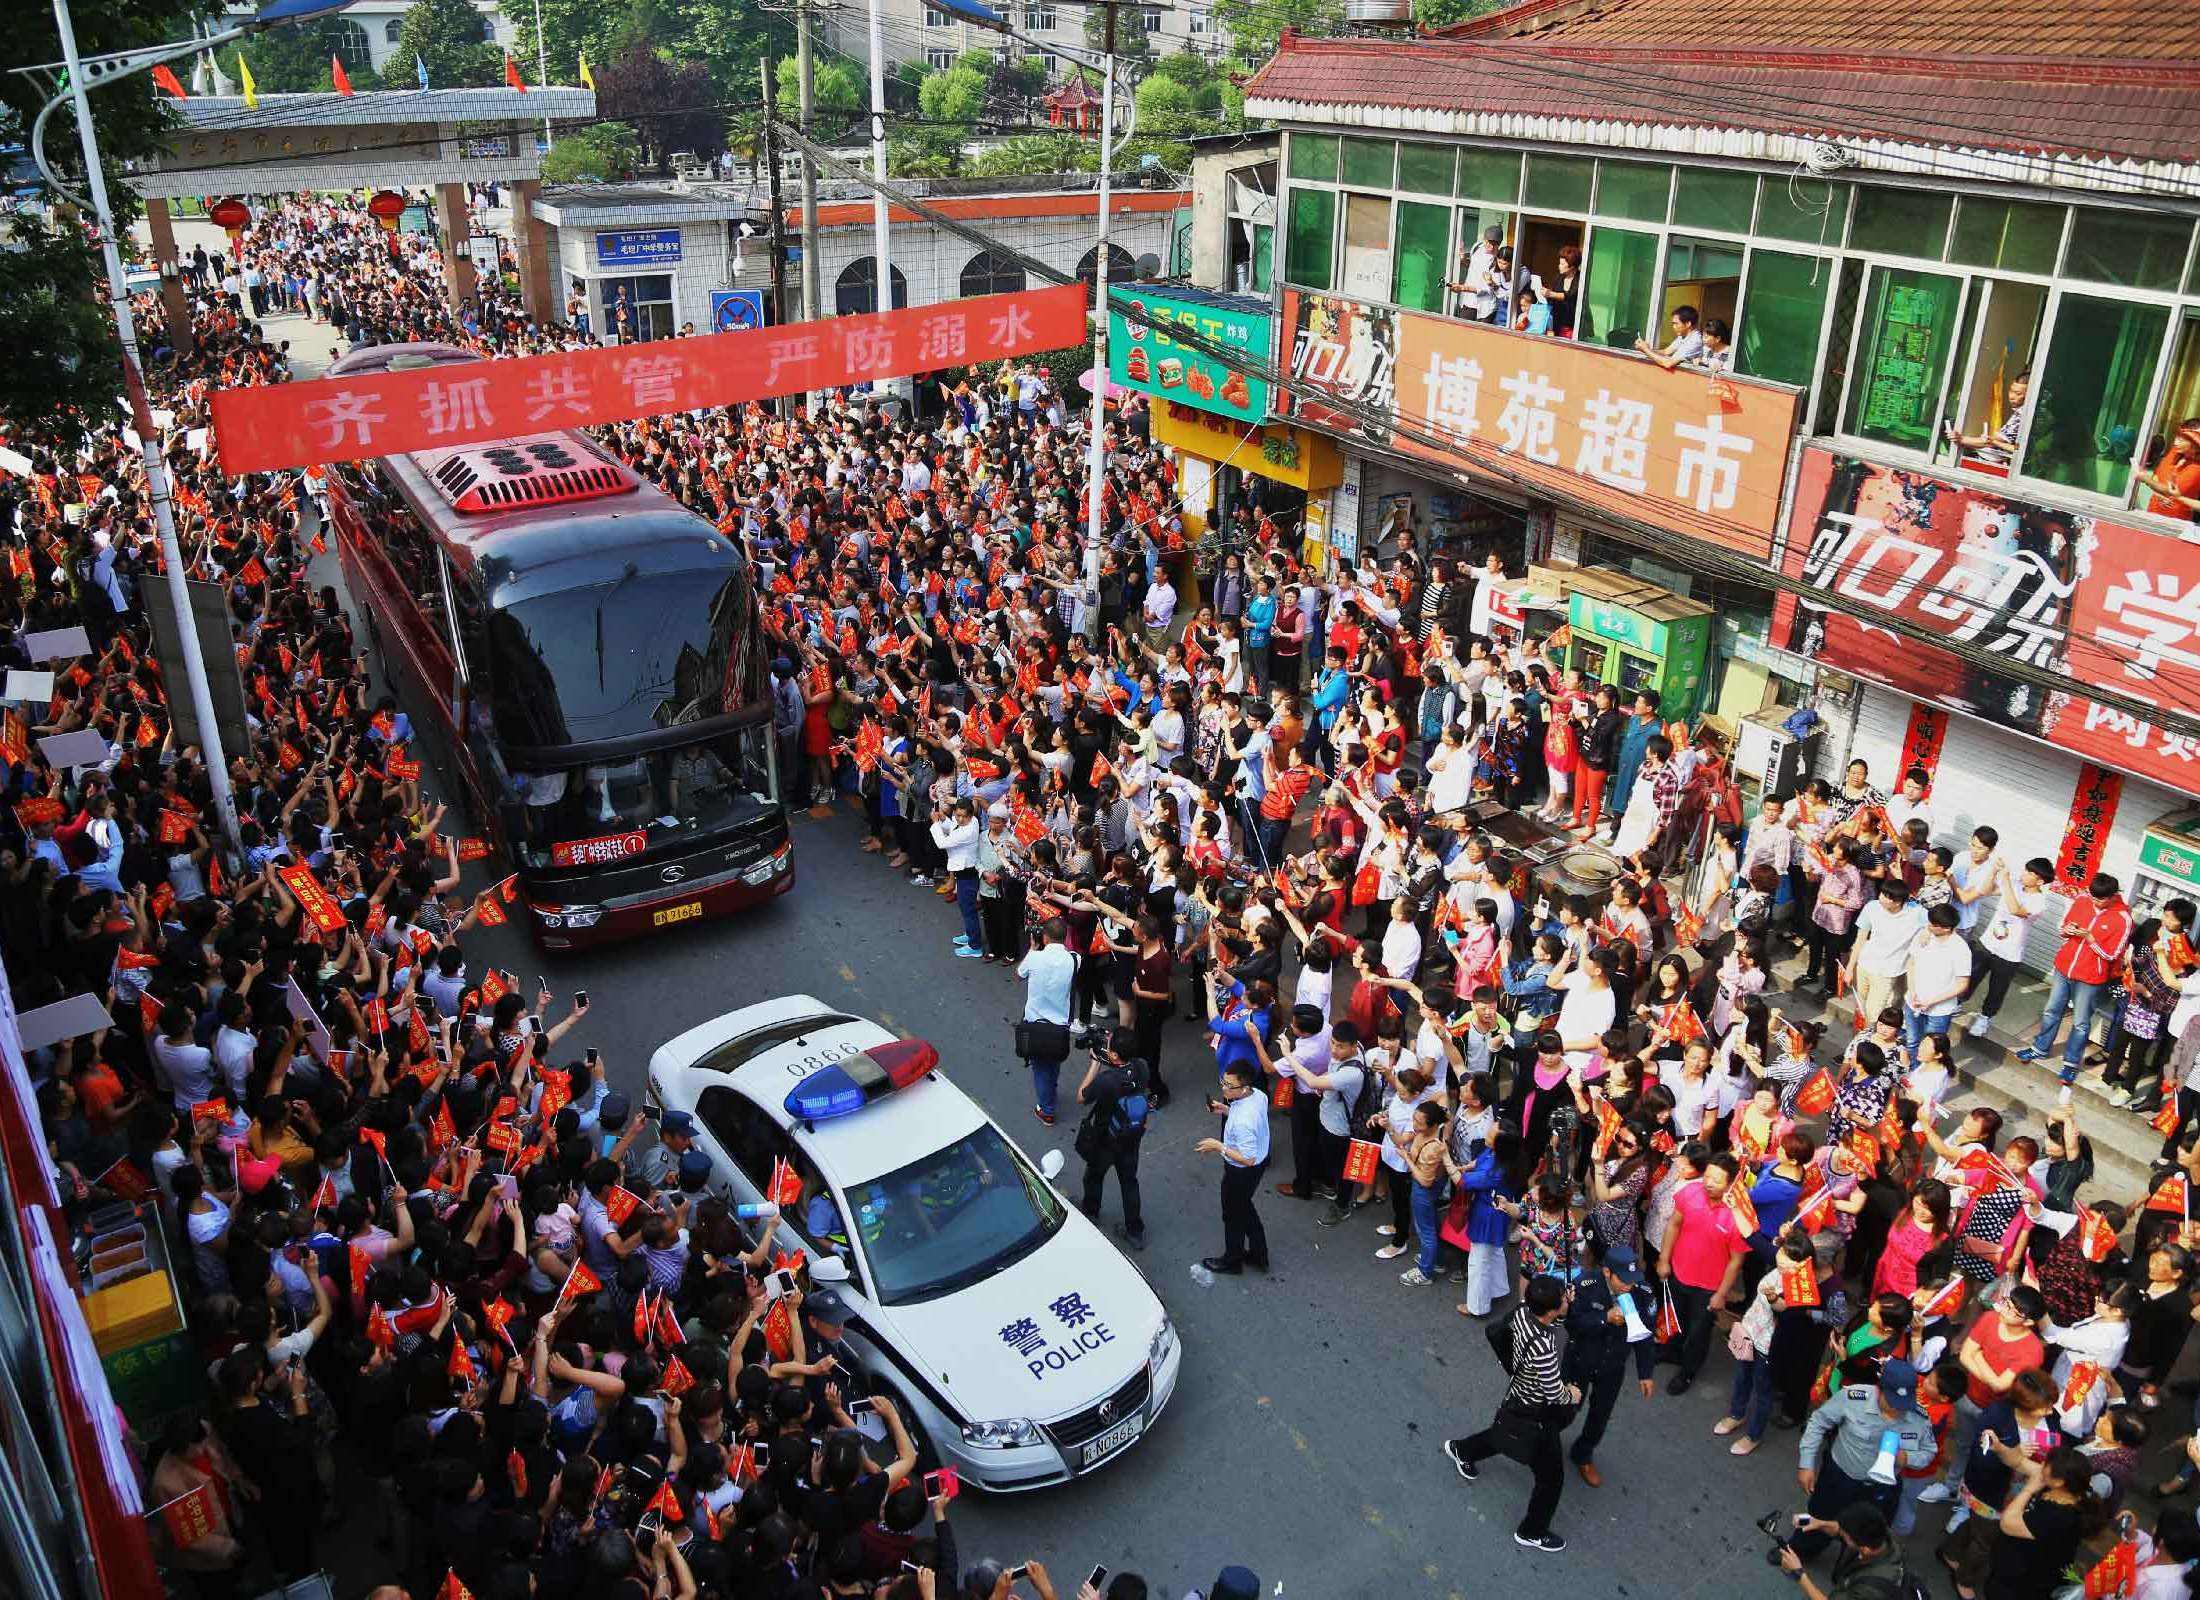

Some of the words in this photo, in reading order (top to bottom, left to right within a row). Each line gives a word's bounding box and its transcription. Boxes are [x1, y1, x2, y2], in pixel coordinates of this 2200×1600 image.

[309, 354, 685, 448] 齐抓共管
[765, 303, 1033, 387] 严防溺水
[1291, 330, 1396, 407] 可口可乐
[1422, 351, 1755, 515] 博苑超市
[1803, 511, 2078, 672] 可口可乐
[786, 1042, 860, 1077] 0866
[998, 1291, 1095, 1357] 警察
[1026, 1322, 1116, 1381] POLICE
